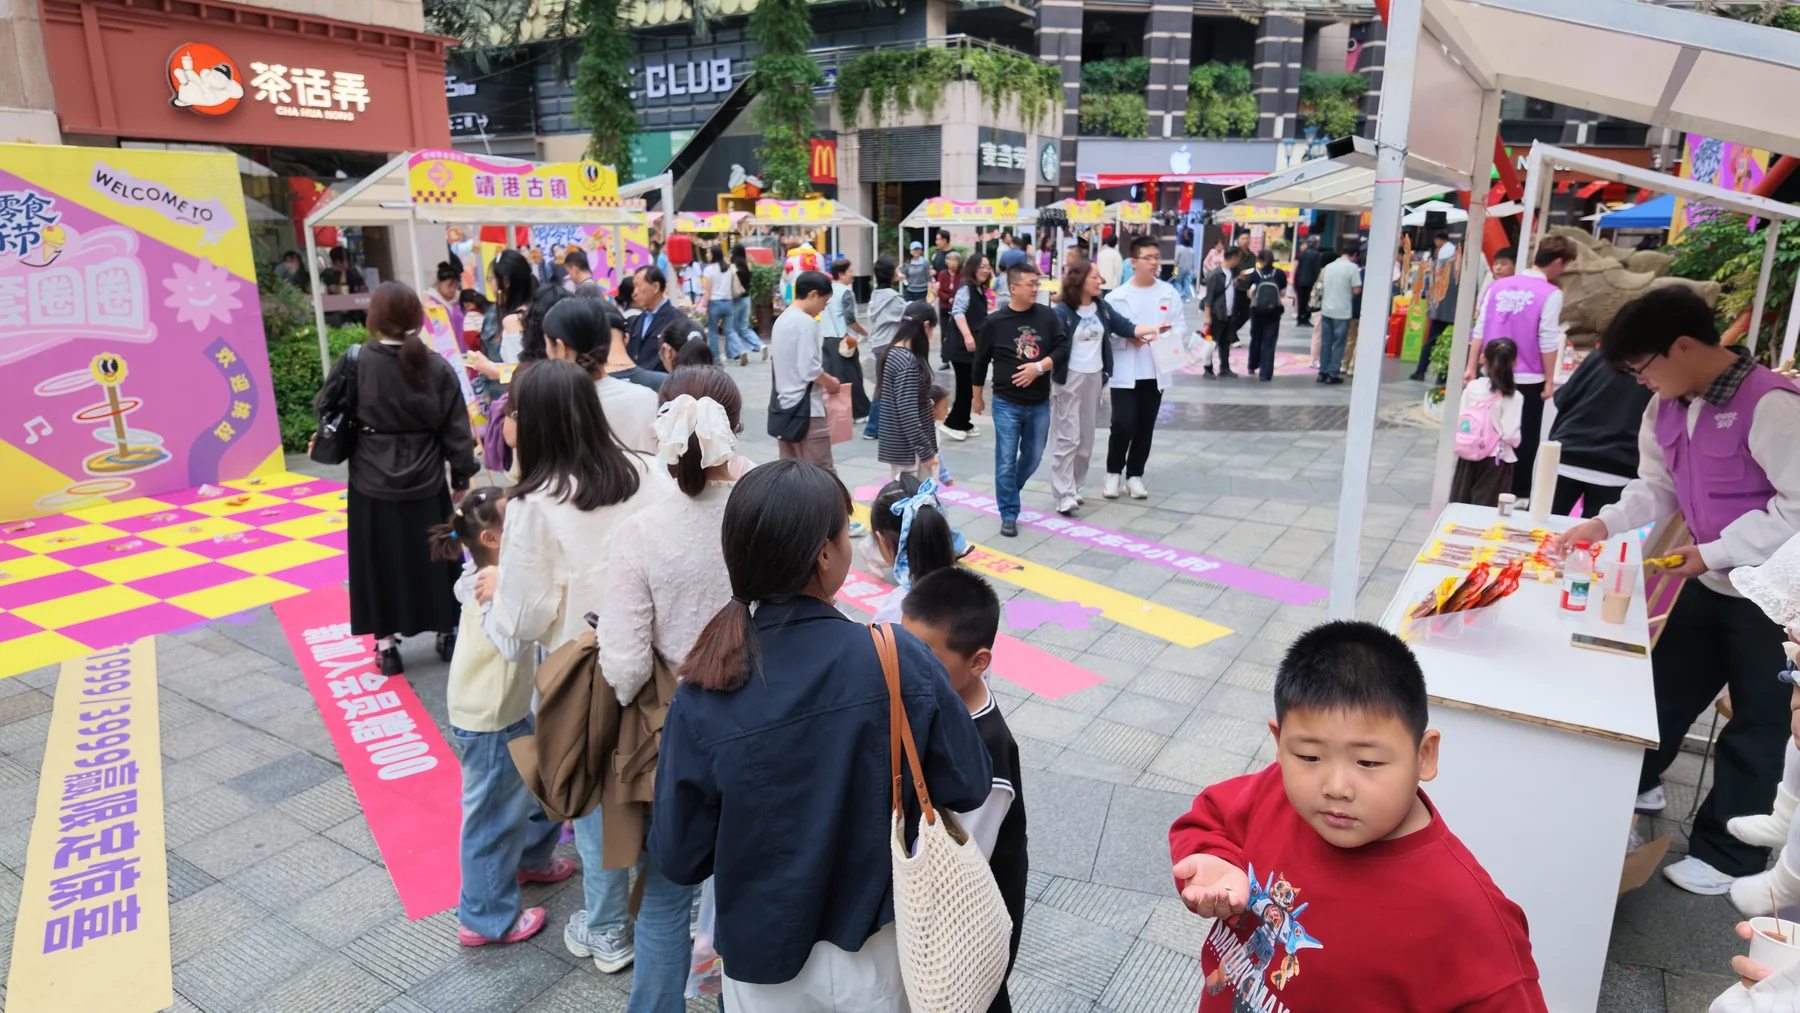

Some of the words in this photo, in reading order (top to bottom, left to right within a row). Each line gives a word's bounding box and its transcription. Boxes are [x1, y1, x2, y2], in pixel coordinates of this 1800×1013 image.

[250, 62, 371, 112] 茶话弄
[646, 58, 732, 98] CLUB
[96, 170, 189, 213] WELCOME
[192, 206, 213, 221] TO
[475, 175, 569, 200] 靖港古镇
[42, 640, 141, 955] 1999/3999赢限定惊喜
